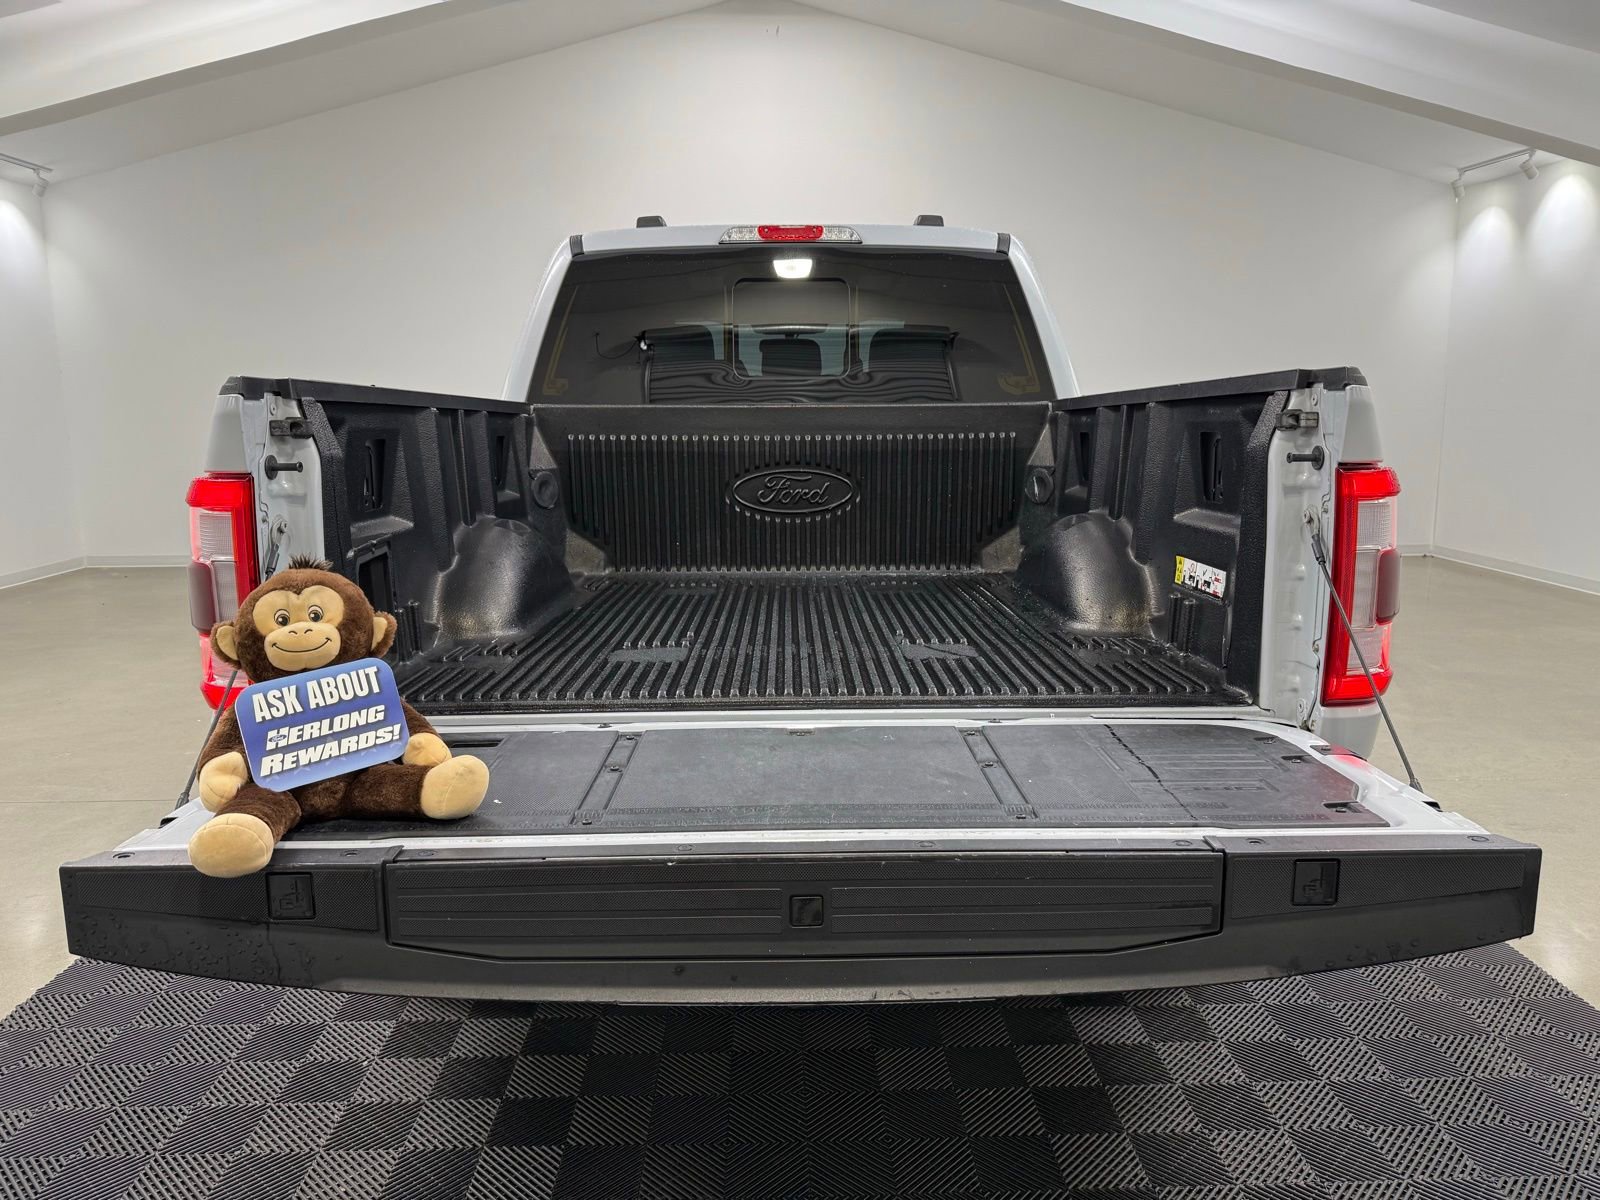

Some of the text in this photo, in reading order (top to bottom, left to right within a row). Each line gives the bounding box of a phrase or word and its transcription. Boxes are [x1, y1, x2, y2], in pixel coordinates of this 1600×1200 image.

[757, 474, 830, 503] Ford
[252, 666, 380, 723] ASK ABOUT
[260, 723, 402, 777] REWARDS!
[266, 704, 386, 751] HERLONG
